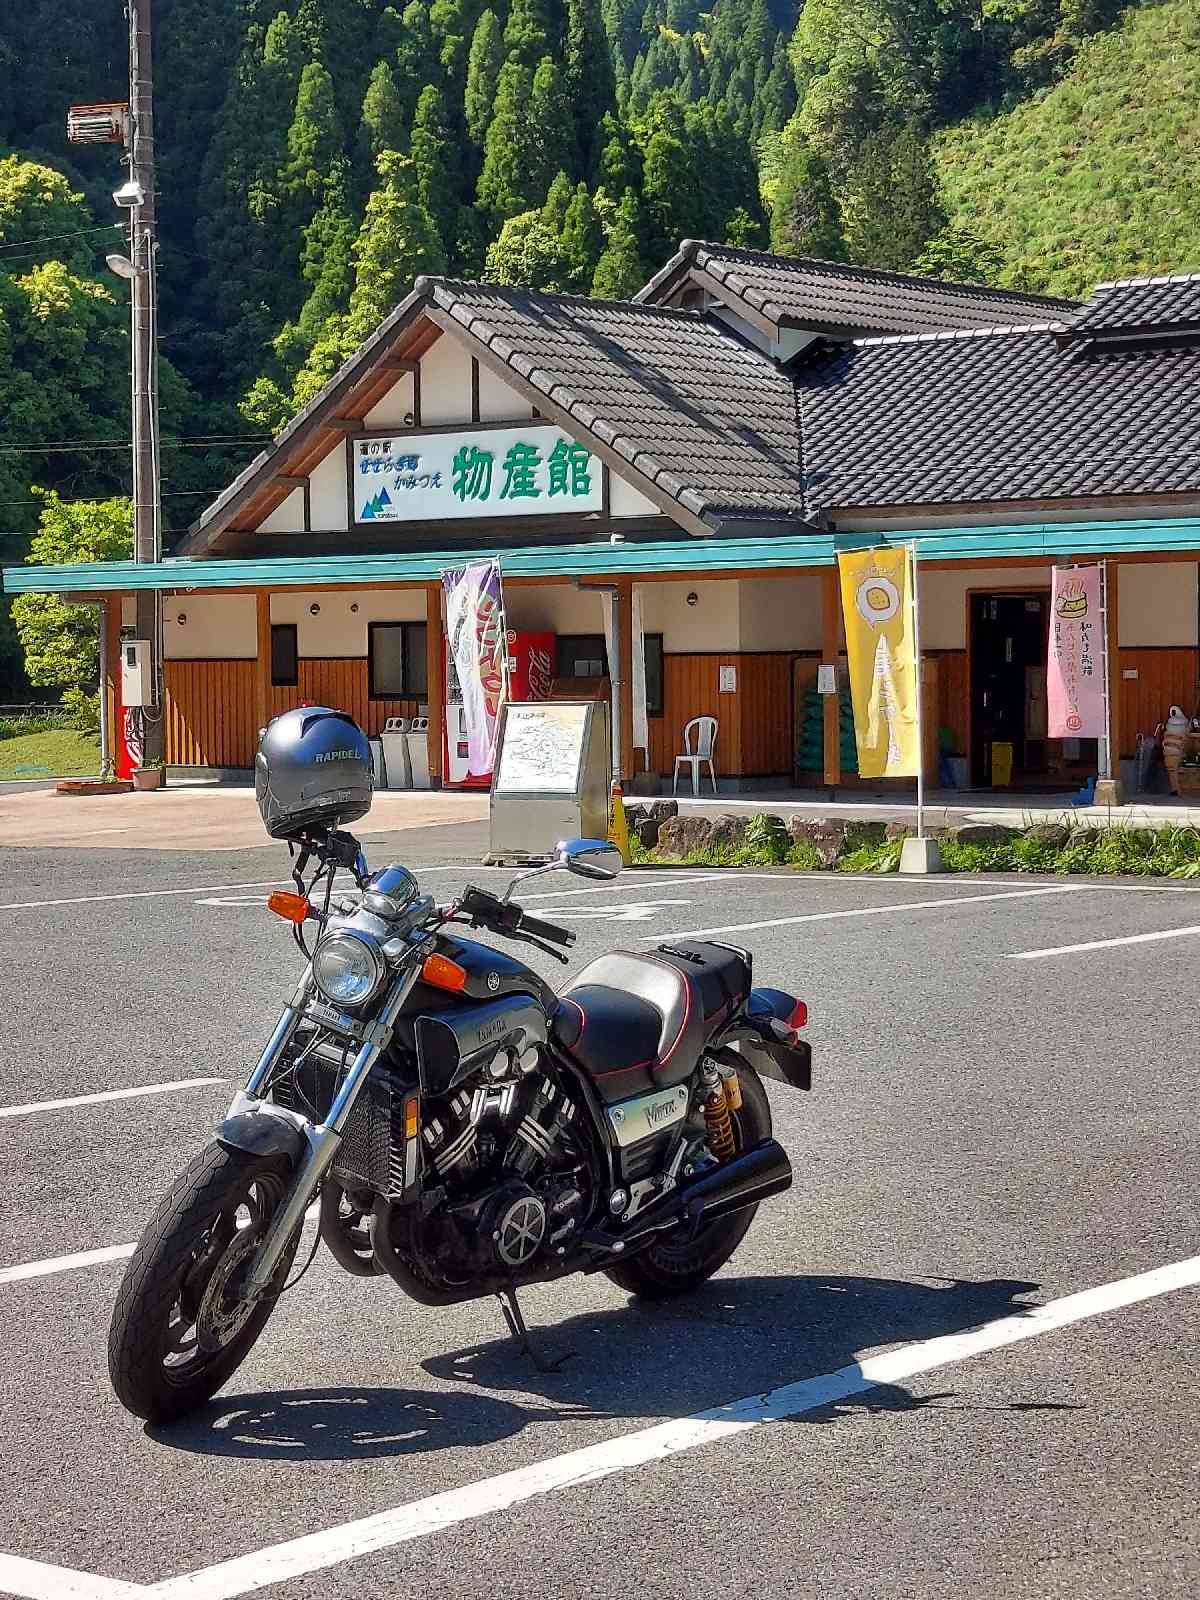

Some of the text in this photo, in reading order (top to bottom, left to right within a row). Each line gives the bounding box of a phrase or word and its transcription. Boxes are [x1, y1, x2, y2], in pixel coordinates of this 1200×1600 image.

[360, 441, 392, 455] 道の駅
[452, 438, 592, 501] 物産館
[394, 472, 442, 490] かみつえ
